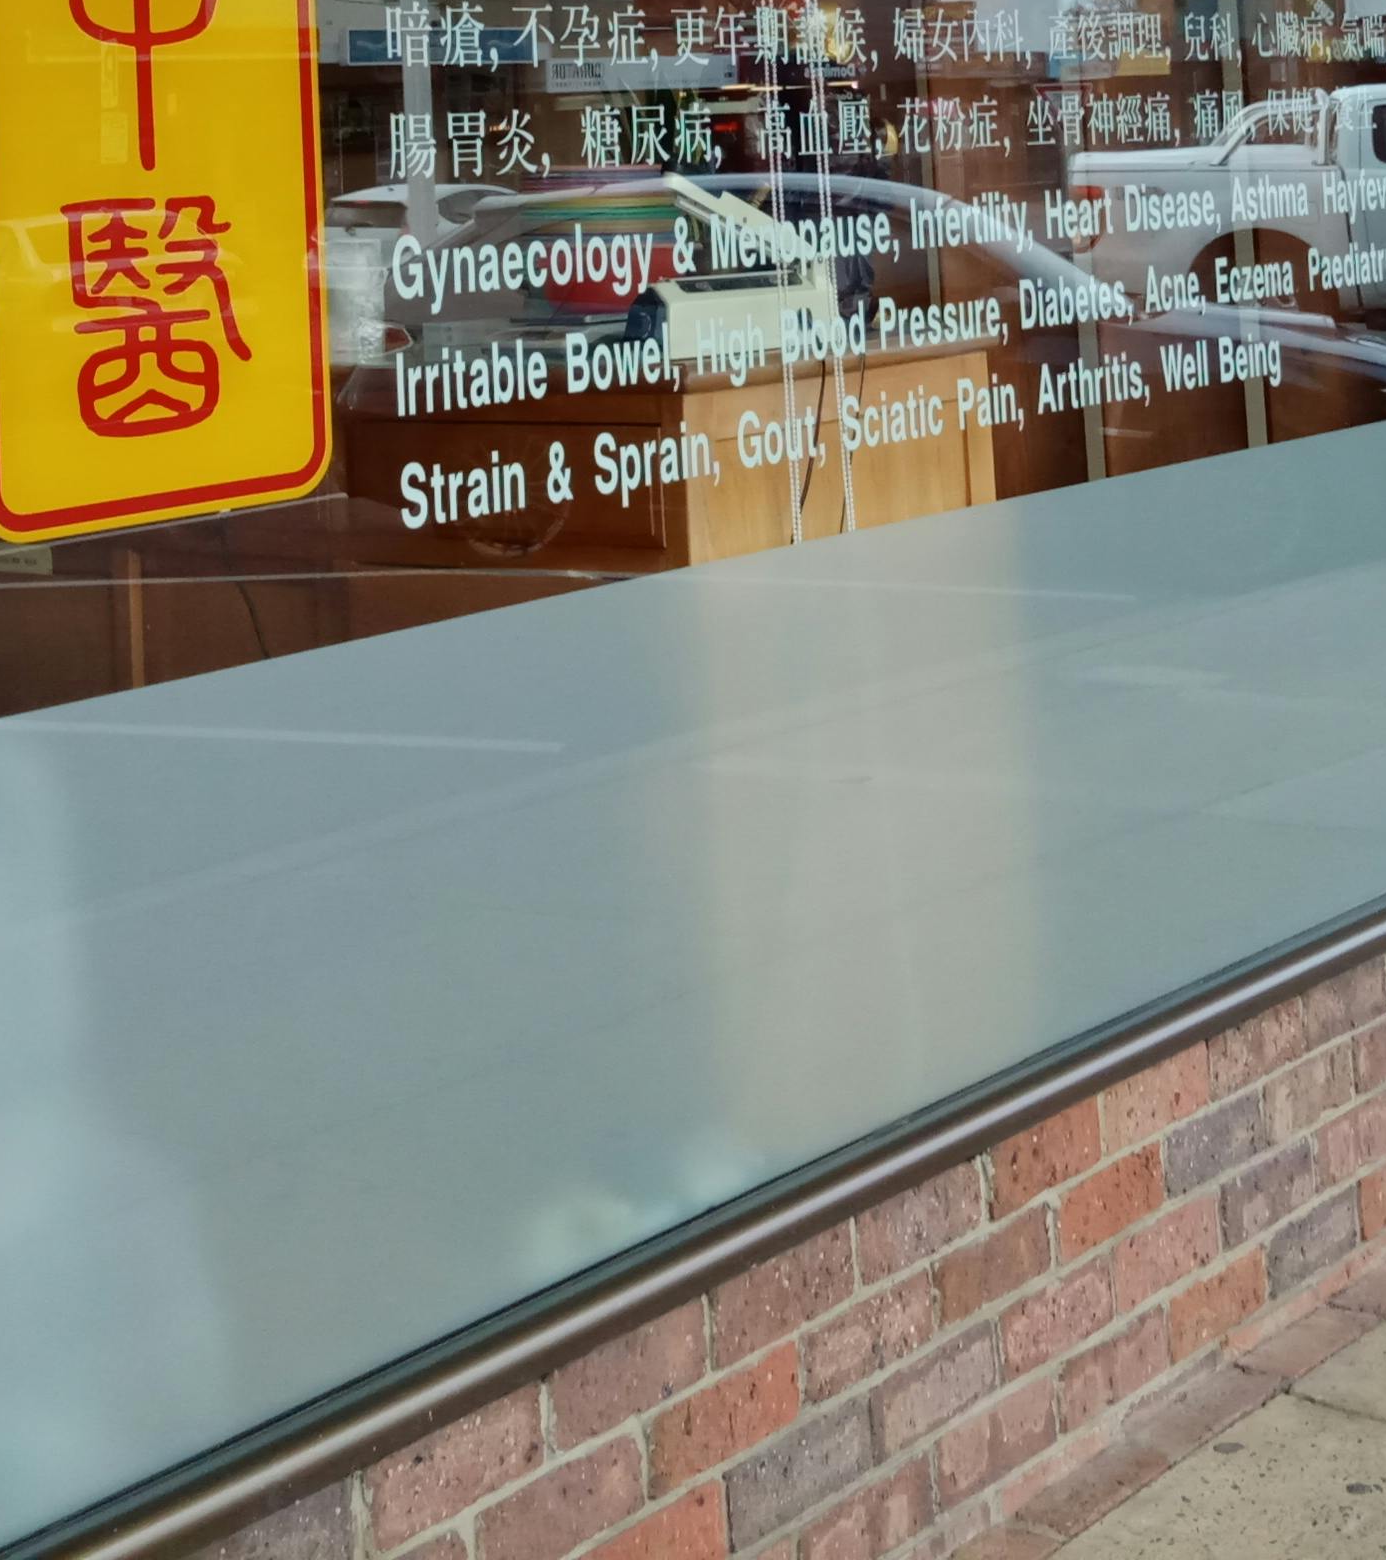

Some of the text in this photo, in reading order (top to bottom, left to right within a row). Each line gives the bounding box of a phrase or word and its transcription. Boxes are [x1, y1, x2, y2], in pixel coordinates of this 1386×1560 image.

[393, 223, 652, 313] Gynaecology
[672, 225, 696, 275] &
[711, 208, 900, 271] Menopause,
[910, 190, 1033, 252] Infertility,
[1044, 189, 1113, 240] Heart
[1125, 183, 1222, 233] Disease,
[1231, 174, 1309, 222] Asthma
[396, 336, 548, 416] Irritable
[567, 322, 681, 393] Bowel,
[695, 314, 765, 387] High
[781, 299, 866, 365] Blood
[879, 292, 1009, 348] Pressure,
[1019, 277, 1134, 330] Diabetes,
[1145, 264, 1206, 313] Acne,
[1215, 253, 1294, 303] Eczema
[400, 335, 1281, 531] Strain & Sprain, Gout, Sciatic Pain, Arthritis, Well Being
